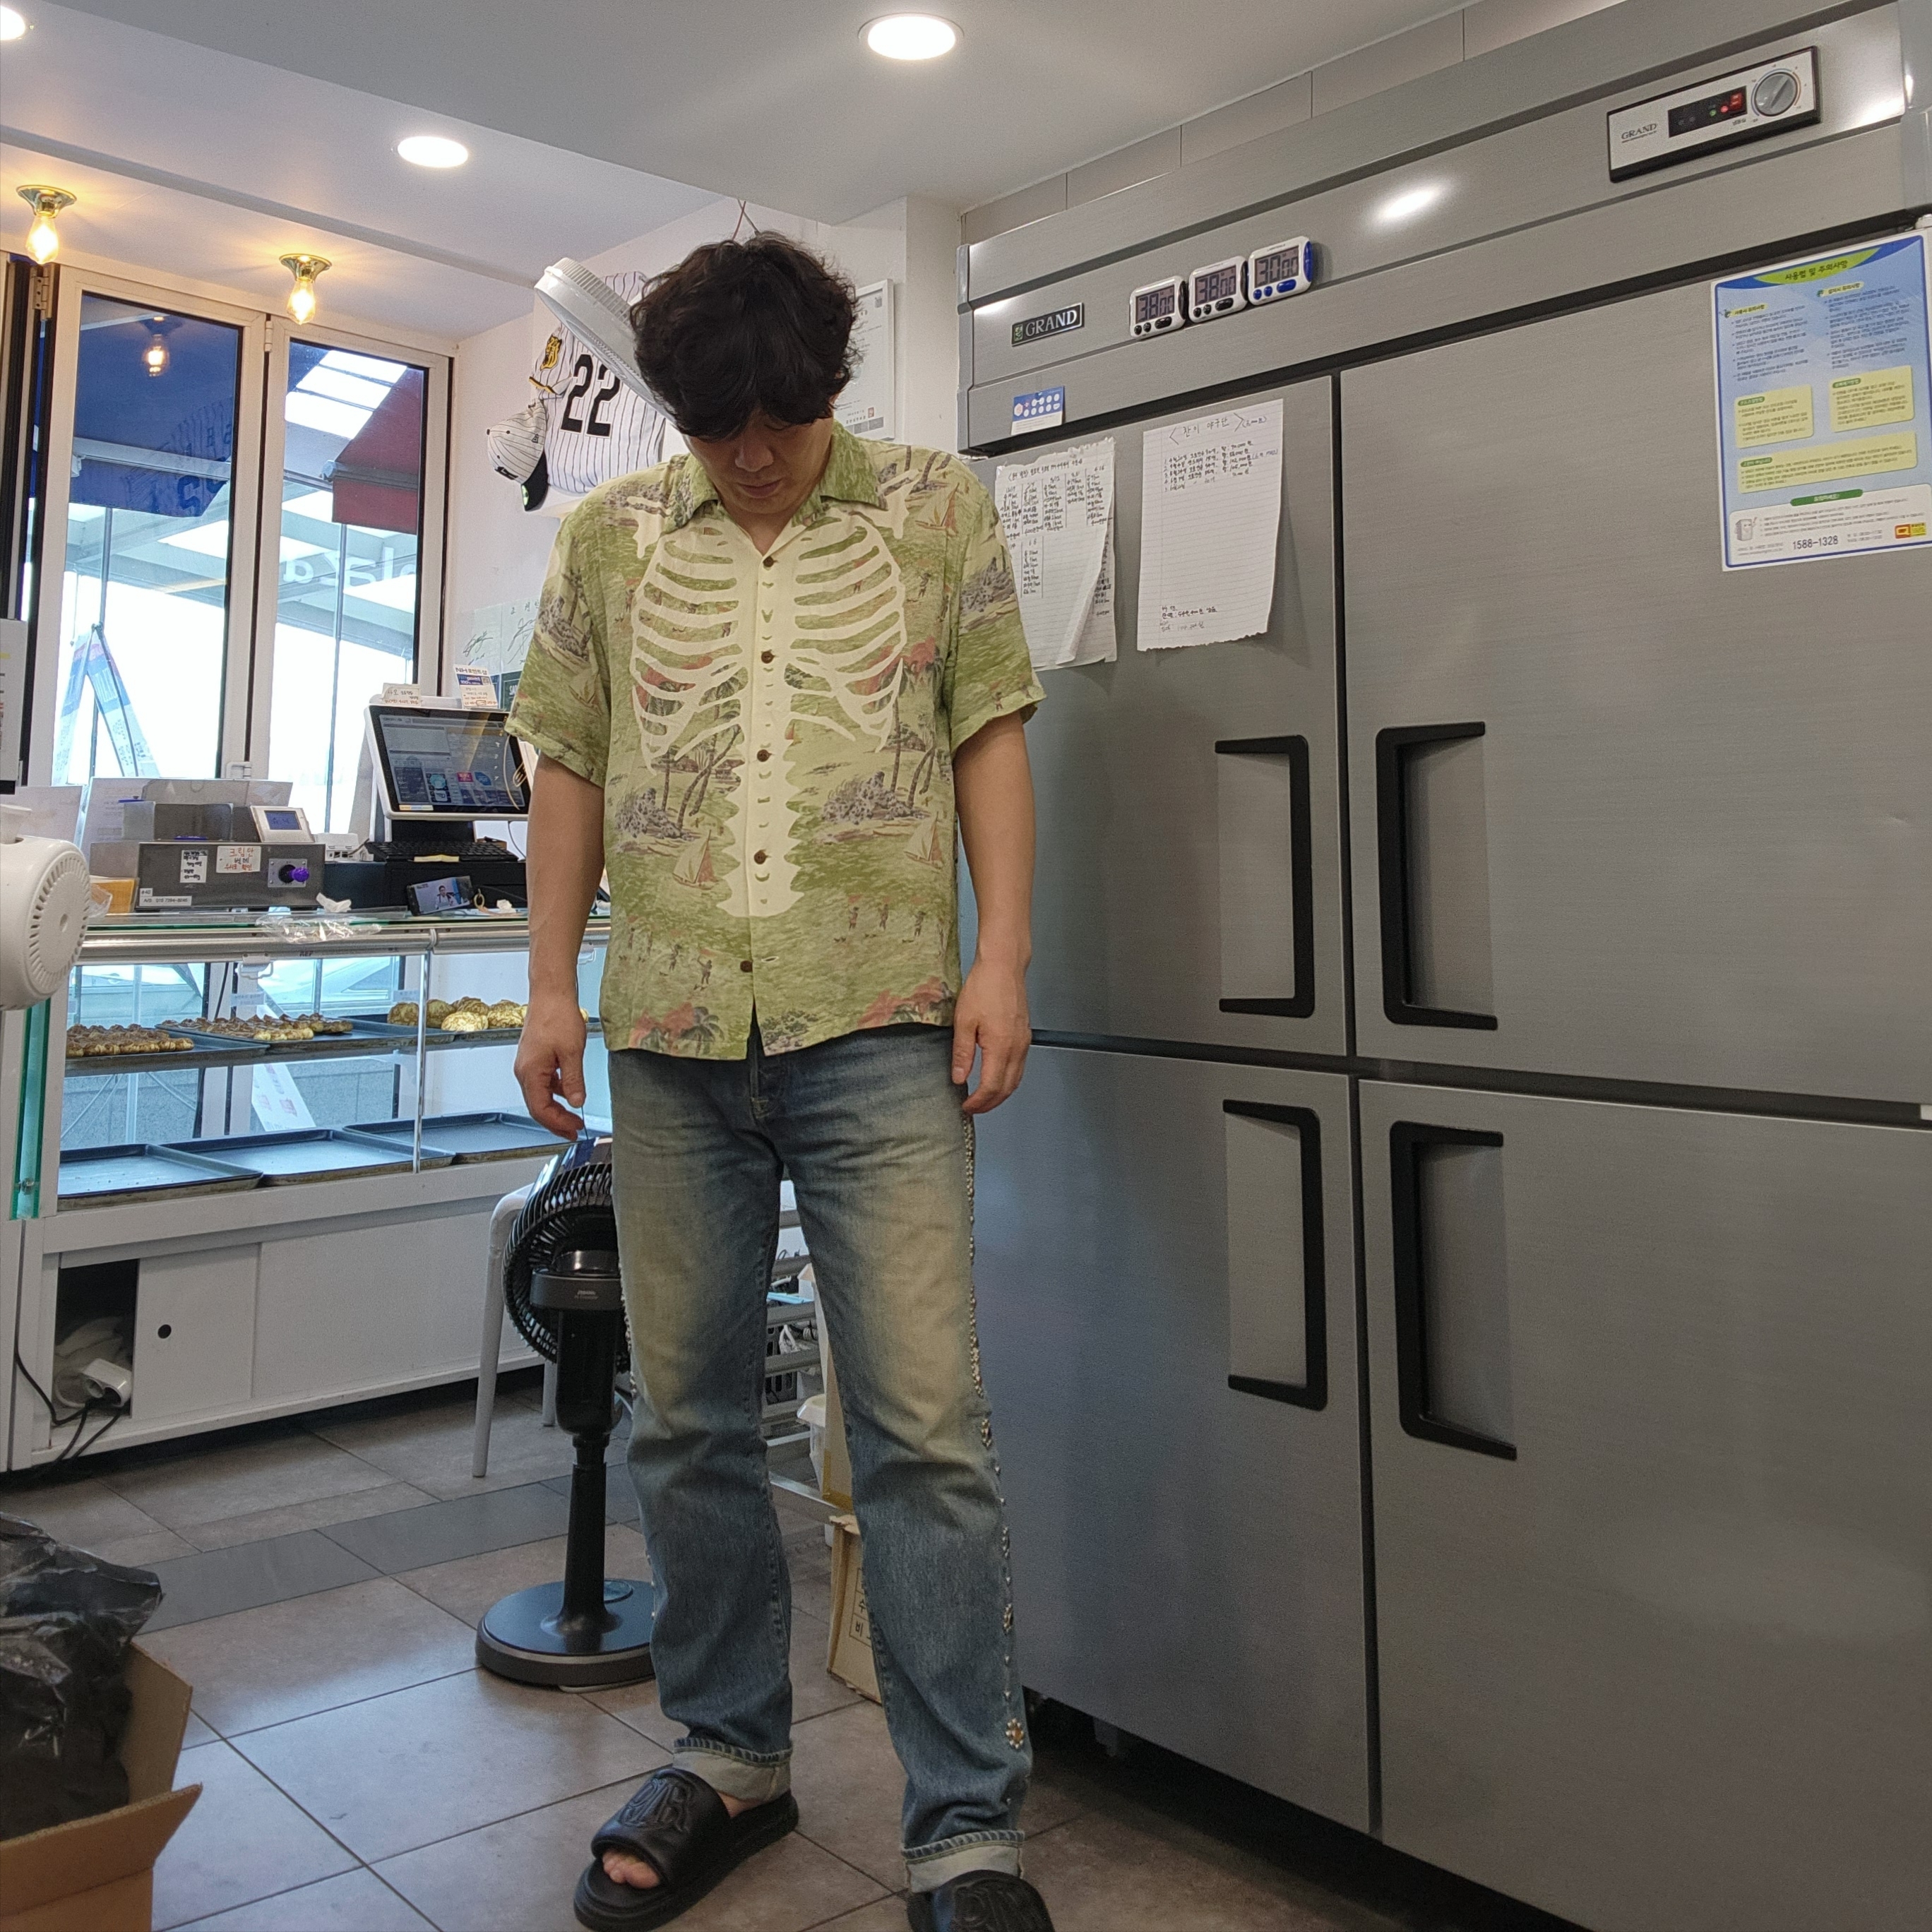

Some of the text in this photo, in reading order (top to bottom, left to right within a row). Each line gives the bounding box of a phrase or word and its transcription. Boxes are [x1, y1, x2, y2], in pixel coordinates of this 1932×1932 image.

[1621, 124, 1657, 140] GRAND
[1808, 267, 1816, 276] 및
[1818, 260, 1848, 273] 주의사항
[1025, 309, 1078, 337] GRAND
[561, 354, 621, 437] 22
[1793, 535, 1838, 550] 1588-1328
